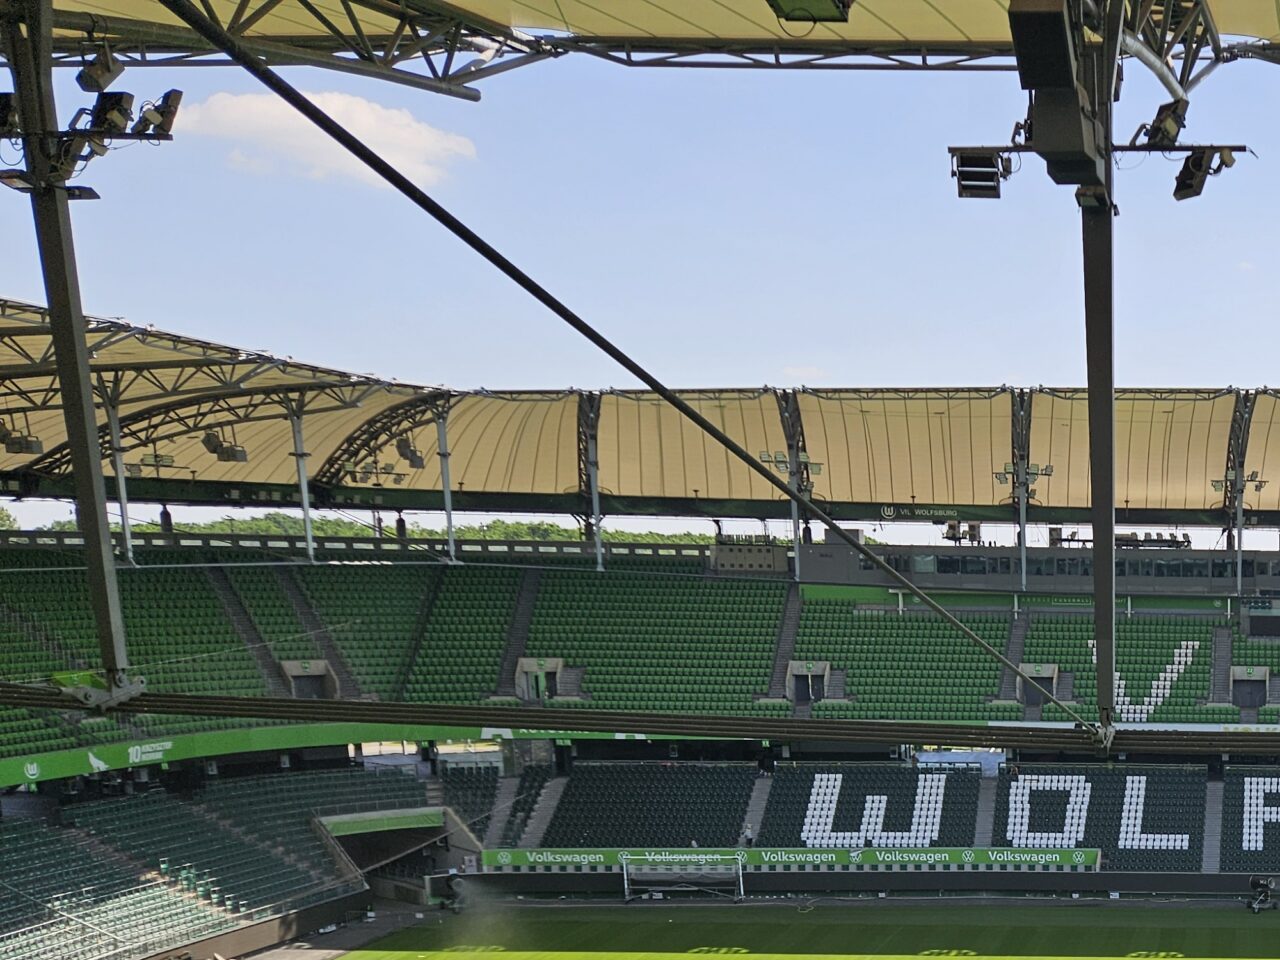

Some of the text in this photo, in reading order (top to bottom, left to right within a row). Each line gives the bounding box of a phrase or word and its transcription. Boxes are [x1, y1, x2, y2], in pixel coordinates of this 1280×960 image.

[914, 508, 958, 517] WOLFSBURG
[128, 745, 141, 763] 10
[526, 851, 604, 864] Volkswagen
[761, 850, 836, 863] Volkswagen
[876, 850, 949, 863] Volkswagen
[988, 850, 1060, 863] Volkswagen
